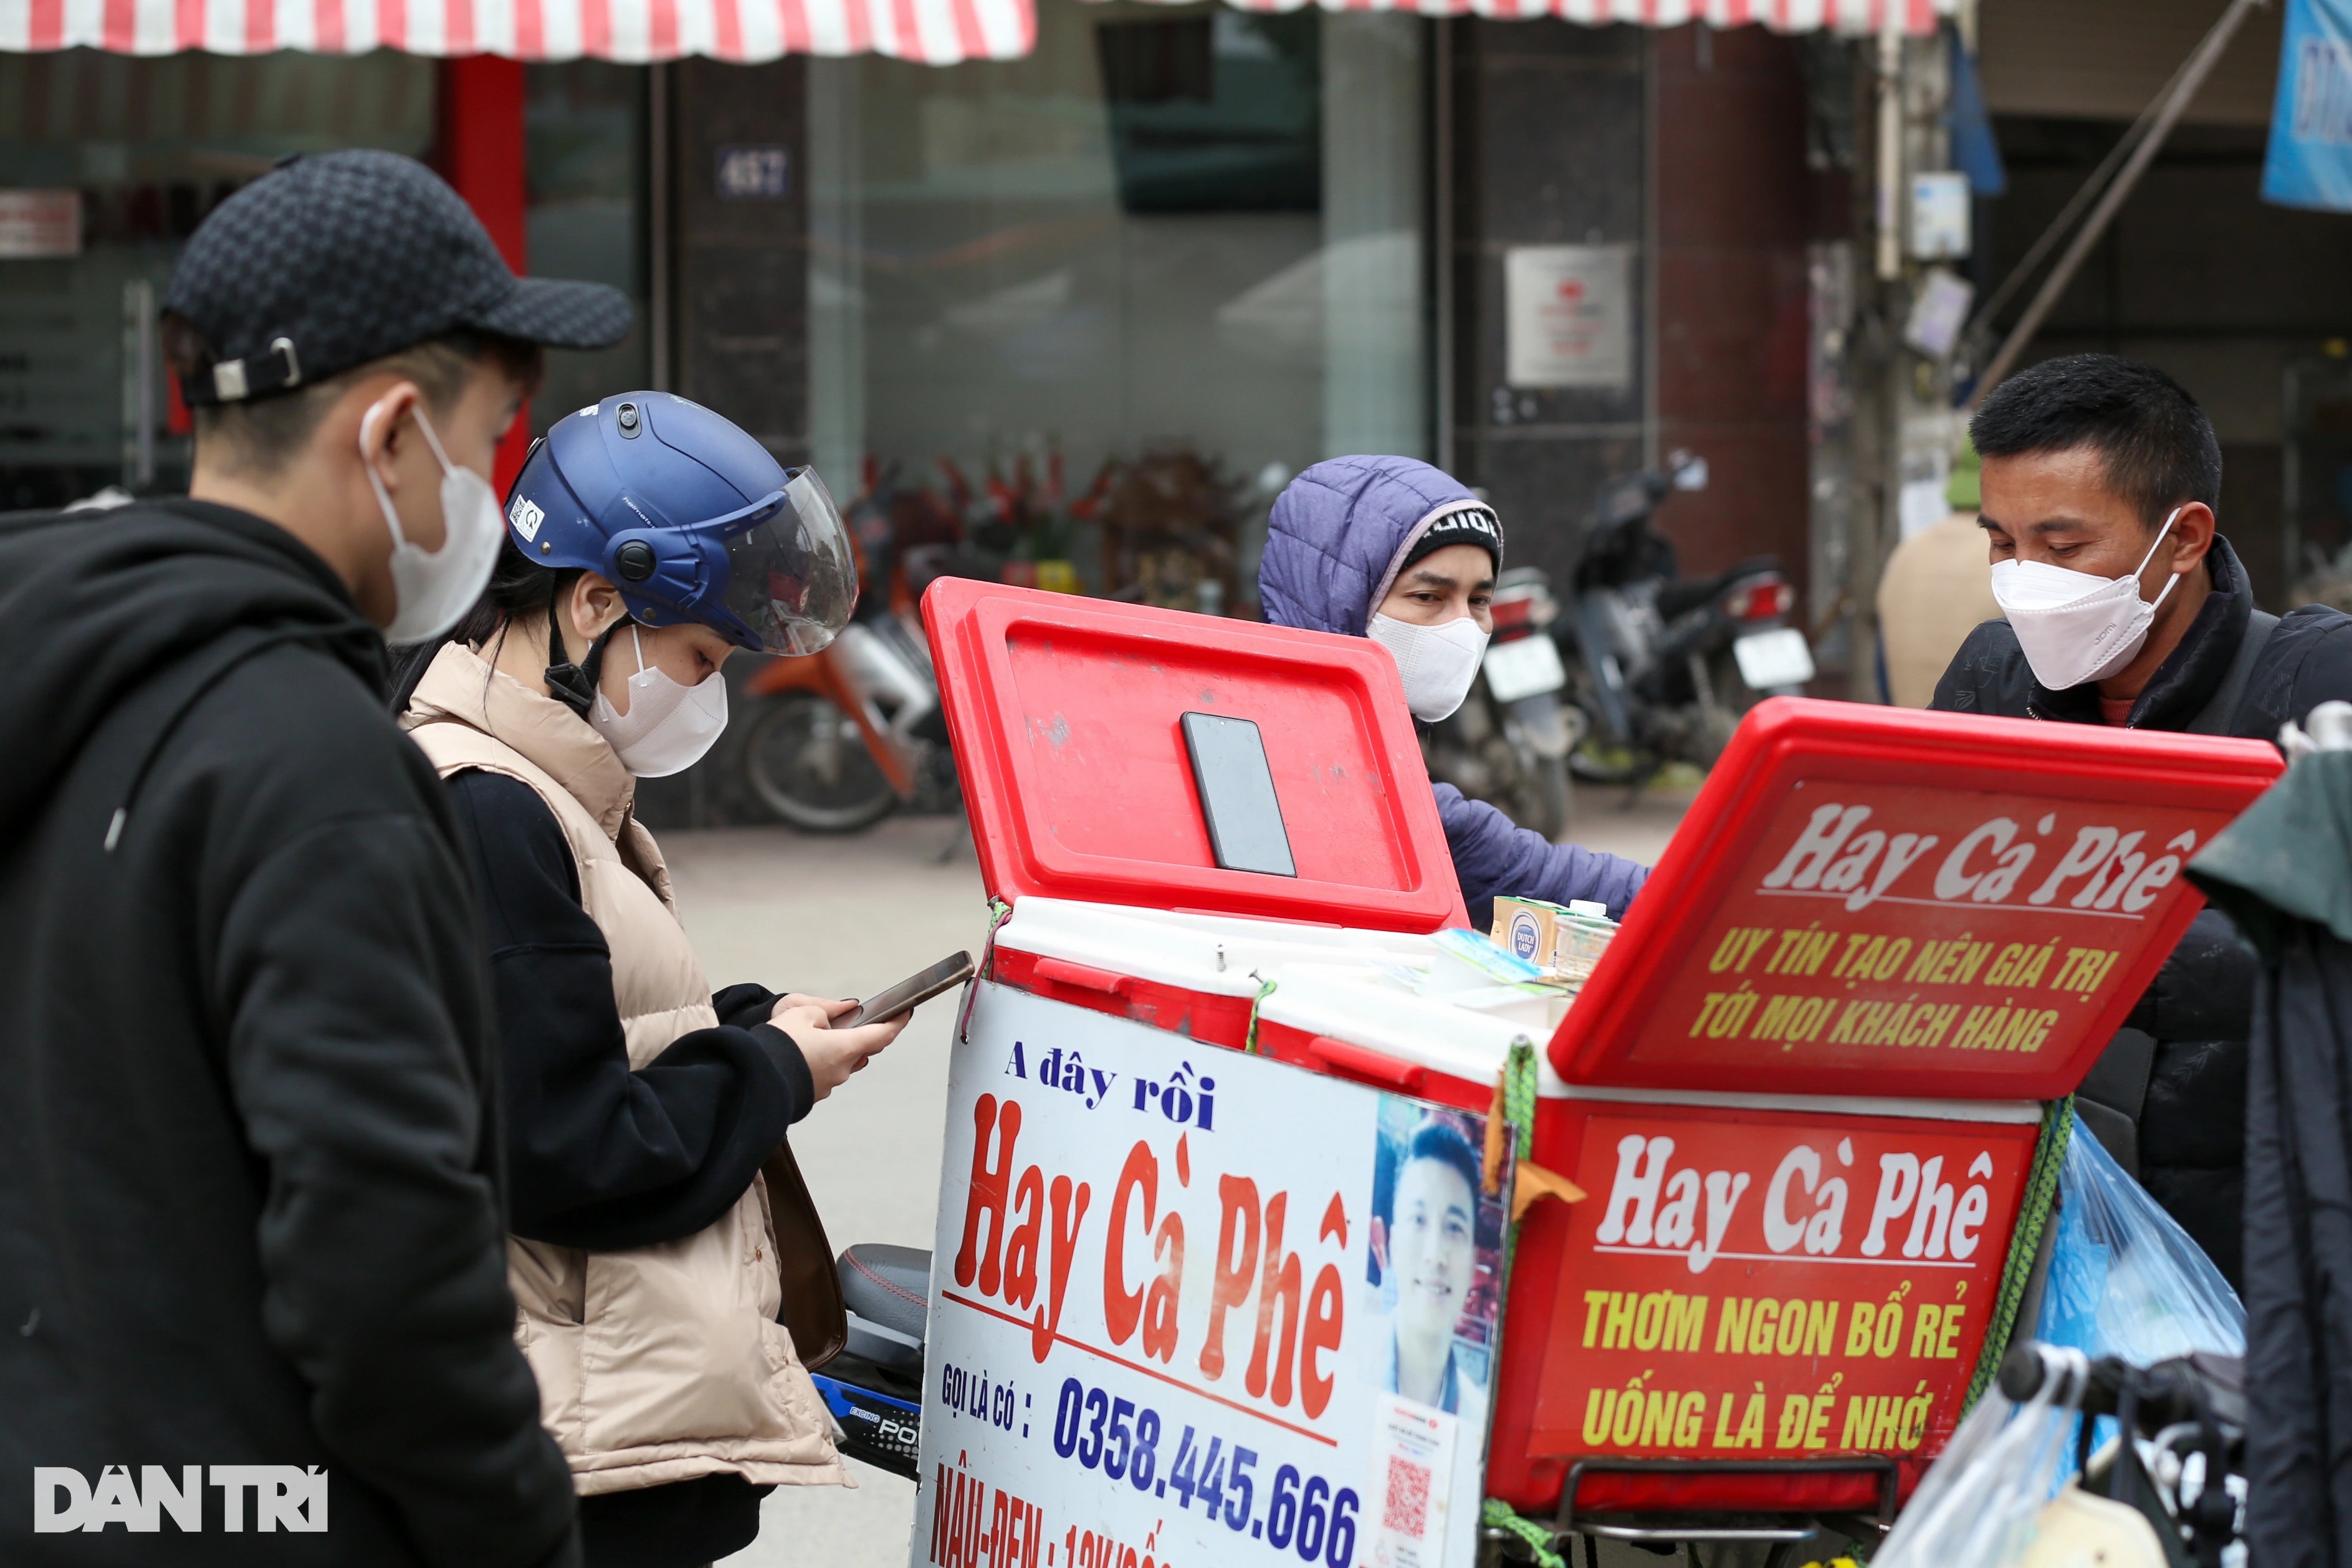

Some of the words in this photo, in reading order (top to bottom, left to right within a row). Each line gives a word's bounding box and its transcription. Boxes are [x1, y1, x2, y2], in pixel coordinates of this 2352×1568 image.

[1762, 803, 1938, 912] Hay
[1934, 813, 2056, 904] Cà
[2029, 826, 2196, 912] Phê
[1517, 932, 1534, 945] DUTCH
[1518, 942, 1532, 954] LADY
[1709, 927, 1774, 973] UY
[1765, 921, 1839, 976] TÍN
[1832, 933, 1913, 989] TẠO
[1904, 932, 1988, 985] NÊN
[1992, 937, 2062, 988] GIÁ
[2049, 947, 2120, 1002] TRỊ
[1688, 986, 1761, 1039] TỚI
[1749, 996, 1838, 1051] MỌI
[1828, 992, 1956, 1048] KHÁCH
[1949, 997, 2059, 1053] HÀNG
[1005, 1041, 1028, 1079] A
[1040, 1048, 1117, 1109] đây
[1131, 1061, 1215, 1132] rồi
[1596, 1135, 1750, 1274] Hay
[1762, 1137, 1854, 1255] Cà
[1860, 1151, 1992, 1260] Phê
[955, 1093, 1091, 1364] Hay
[1104, 1131, 1190, 1364] Cà
[1200, 1173, 1347, 1420] Phê
[1582, 1289, 1708, 1353] THƠM
[1714, 1296, 1838, 1356] NGON
[1845, 1280, 1911, 1359] BỔ
[1910, 1281, 1967, 1359] RẺ
[1582, 1370, 1706, 1448] UỐNG
[1713, 1381, 1766, 1449] LÀ
[1776, 1372, 1843, 1450] ĐỂ
[1840, 1380, 1934, 1450] NHỚ
[942, 1363, 967, 1418] GỌI
[970, 1369, 987, 1422] LÀ
[993, 1380, 1015, 1431] CÓ
[1053, 1377, 1360, 1568] 0358.445.666
